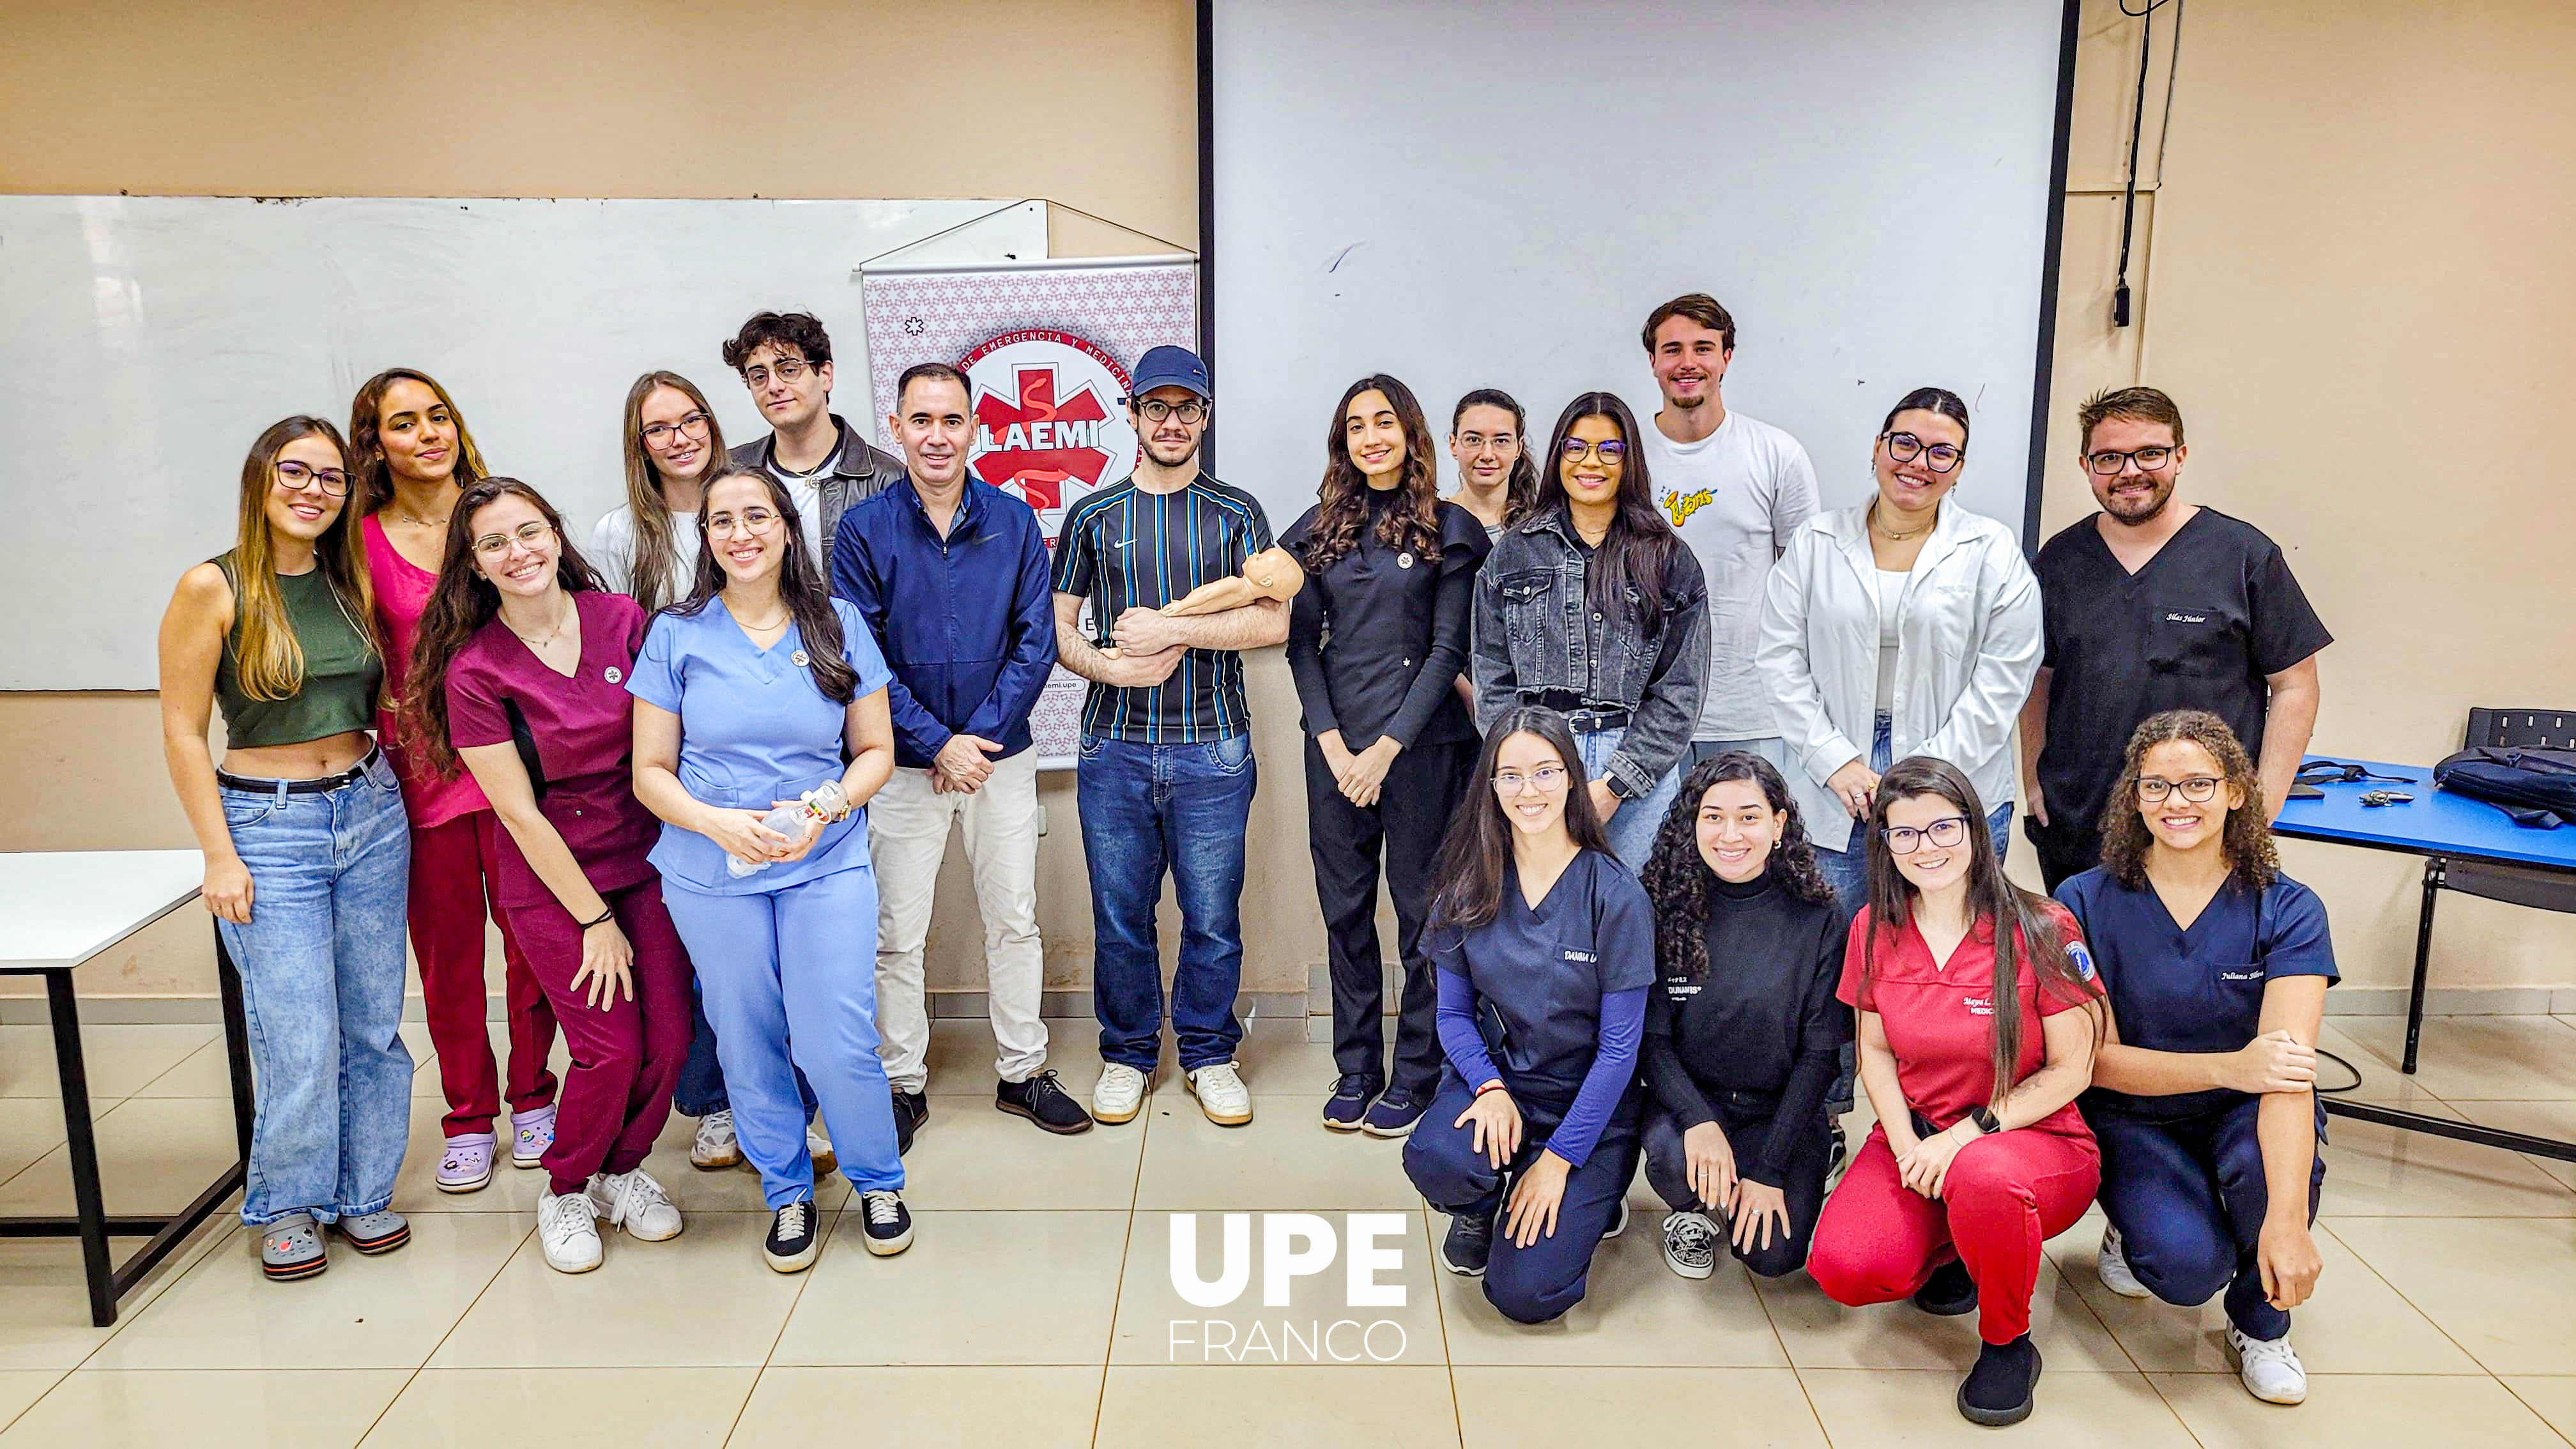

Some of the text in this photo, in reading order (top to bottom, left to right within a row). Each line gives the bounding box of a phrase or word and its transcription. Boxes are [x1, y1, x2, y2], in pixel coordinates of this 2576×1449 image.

[961, 355, 976, 371] DE
[981, 332, 1061, 355] EMERGENCIA
[1072, 338, 1079, 346] Y
[979, 420, 1100, 452] LAEMI
[2166, 613, 2182, 621] Silas
[2221, 972, 2248, 980] Juliana
